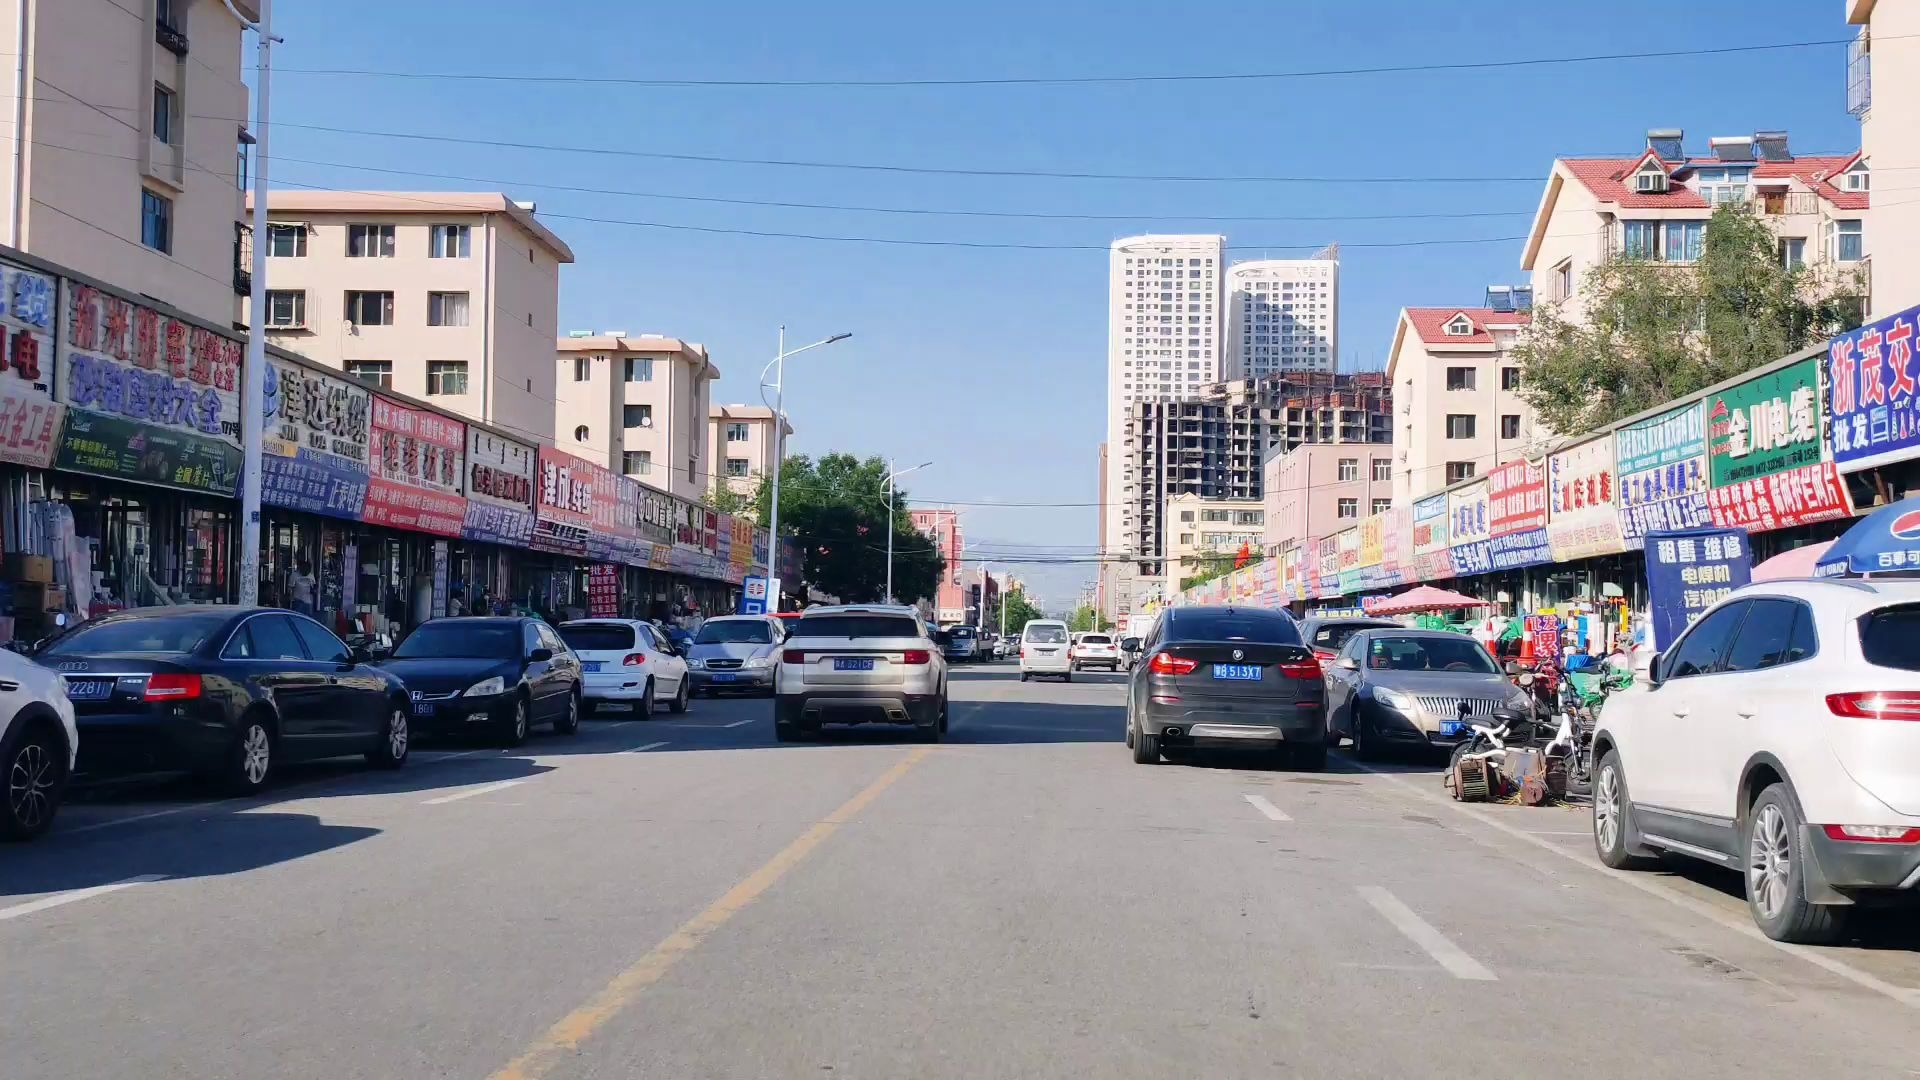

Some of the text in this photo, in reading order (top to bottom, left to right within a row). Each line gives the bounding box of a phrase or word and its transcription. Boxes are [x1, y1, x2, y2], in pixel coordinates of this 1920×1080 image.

[1831, 316, 1920, 416] 浙茂交
[1728, 386, 1817, 460] 金川电缆
[1834, 413, 1869, 454] 批发
[1658, 536, 1742, 564] 租售 维修
[590, 565, 615, 576] 批发
[1681, 564, 1731, 585] 电焊机
